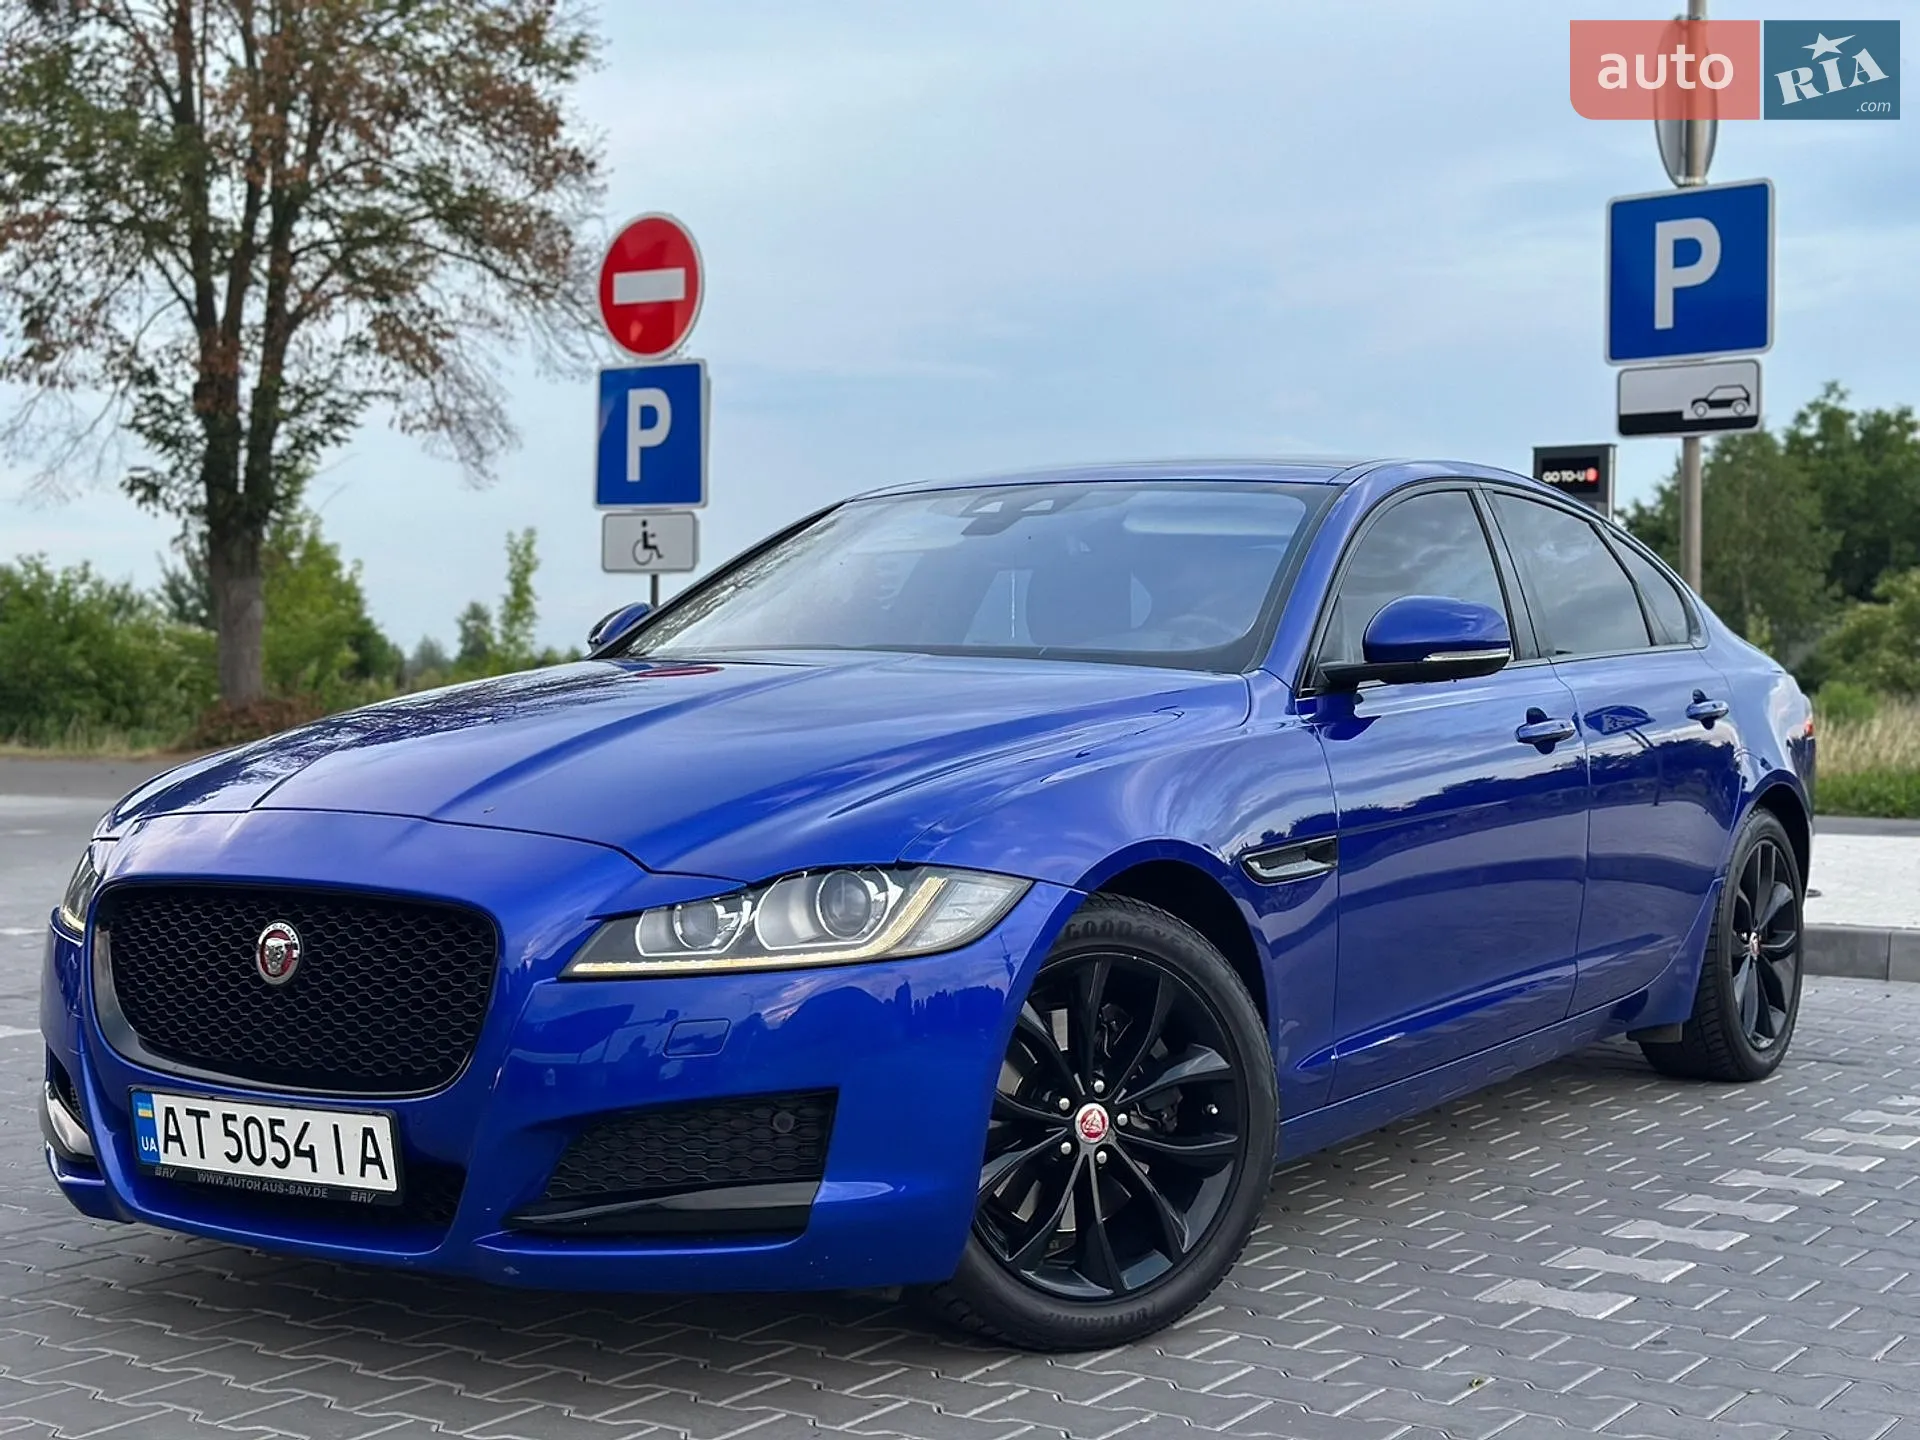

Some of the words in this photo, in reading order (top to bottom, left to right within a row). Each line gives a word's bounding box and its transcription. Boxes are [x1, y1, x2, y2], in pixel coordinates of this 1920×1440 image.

[1654, 217, 1721, 330] P
[626, 387, 672, 482] P
[141, 1135, 158, 1152] UA
[163, 1106, 211, 1160] AT
[221, 1112, 318, 1174] 5054
[333, 1123, 388, 1181] IA
[197, 1171, 329, 1199] WWW.AUTOHAUS-BAV.DE
